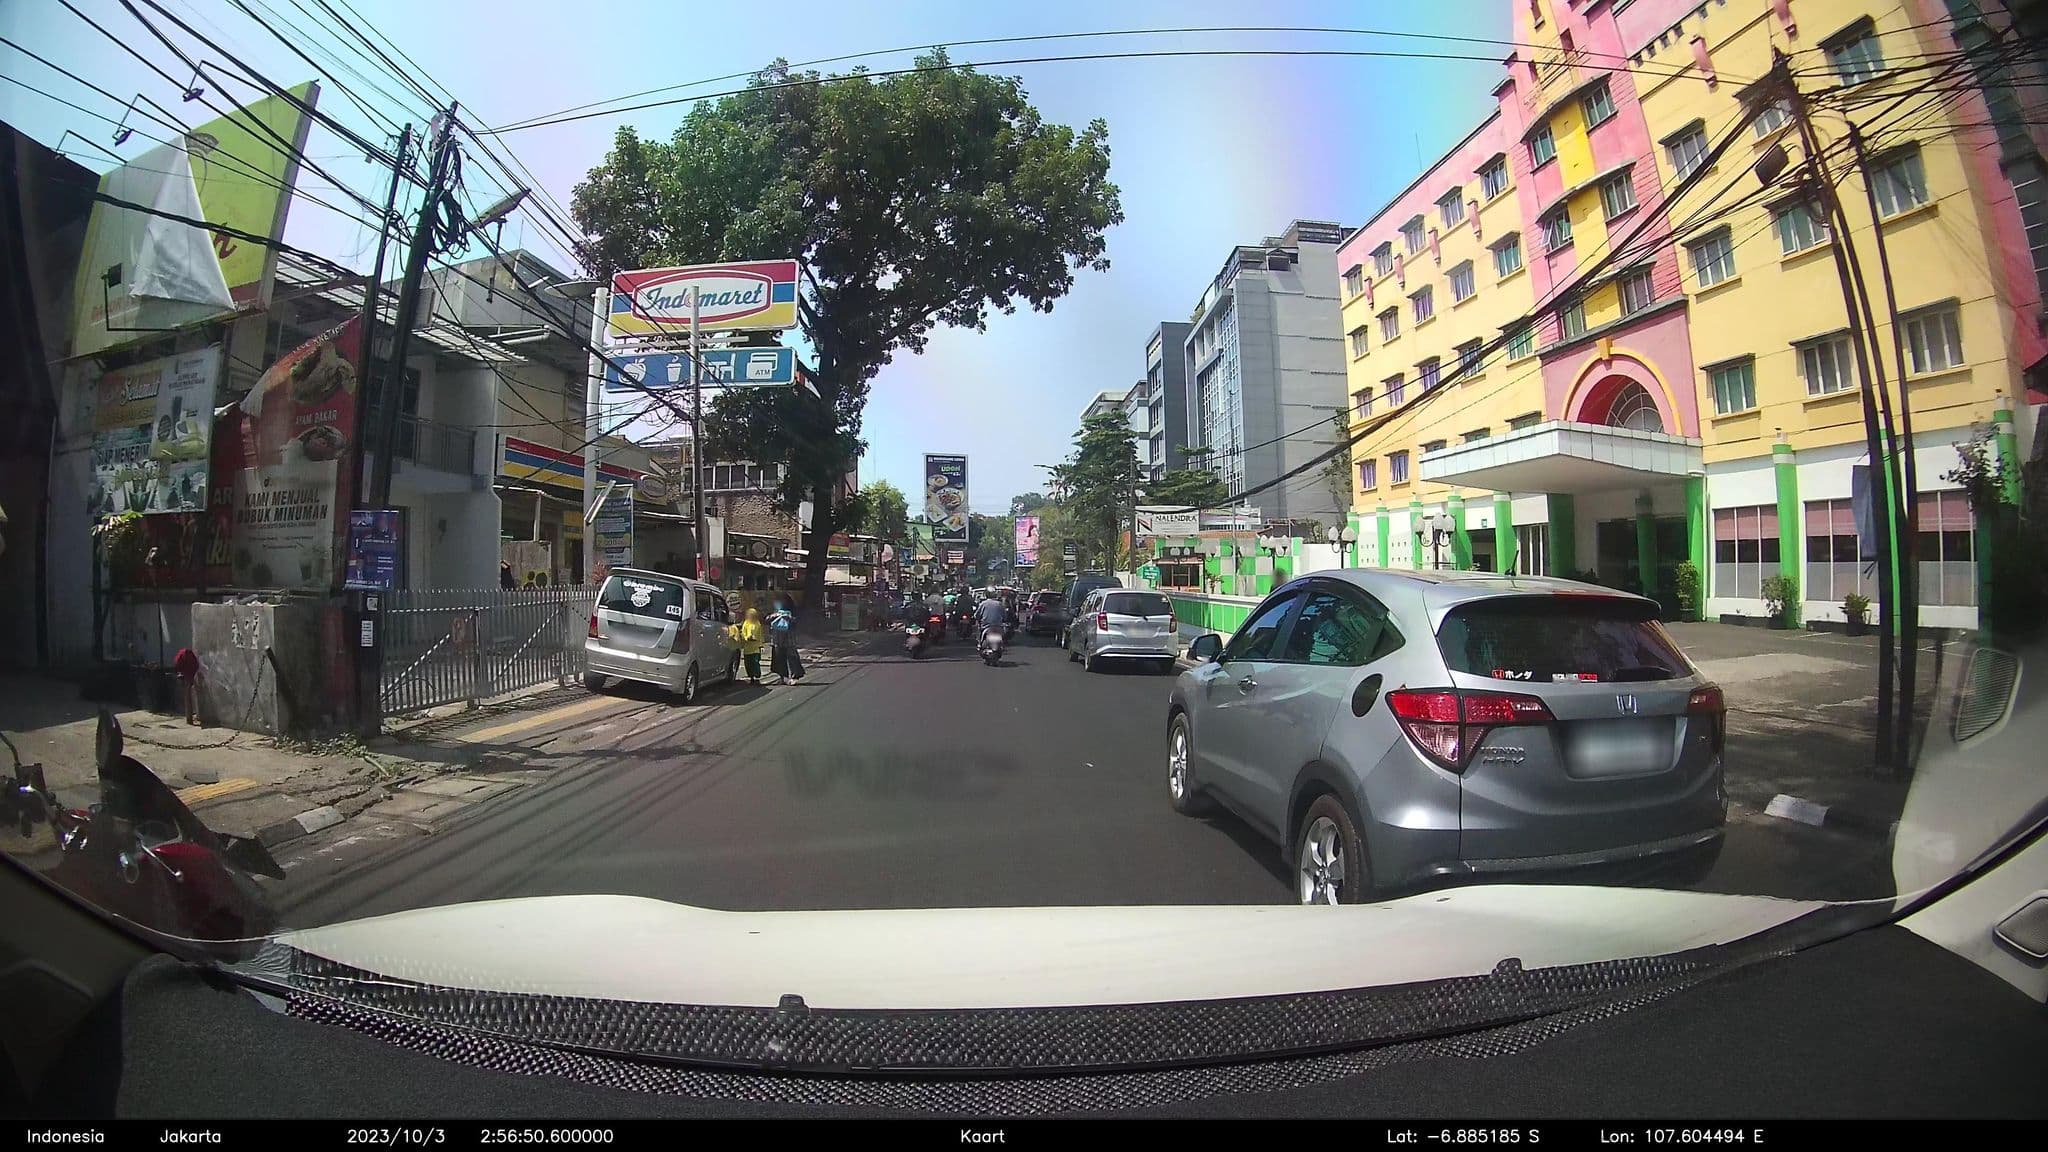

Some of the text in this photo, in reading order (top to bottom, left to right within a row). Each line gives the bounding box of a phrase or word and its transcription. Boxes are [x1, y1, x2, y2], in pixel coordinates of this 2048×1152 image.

[245, 487, 320, 507] KAMI MENJUAL
[273, 504, 328, 522] MINUMAN
[1155, 514, 1197, 522] NALENDRA
